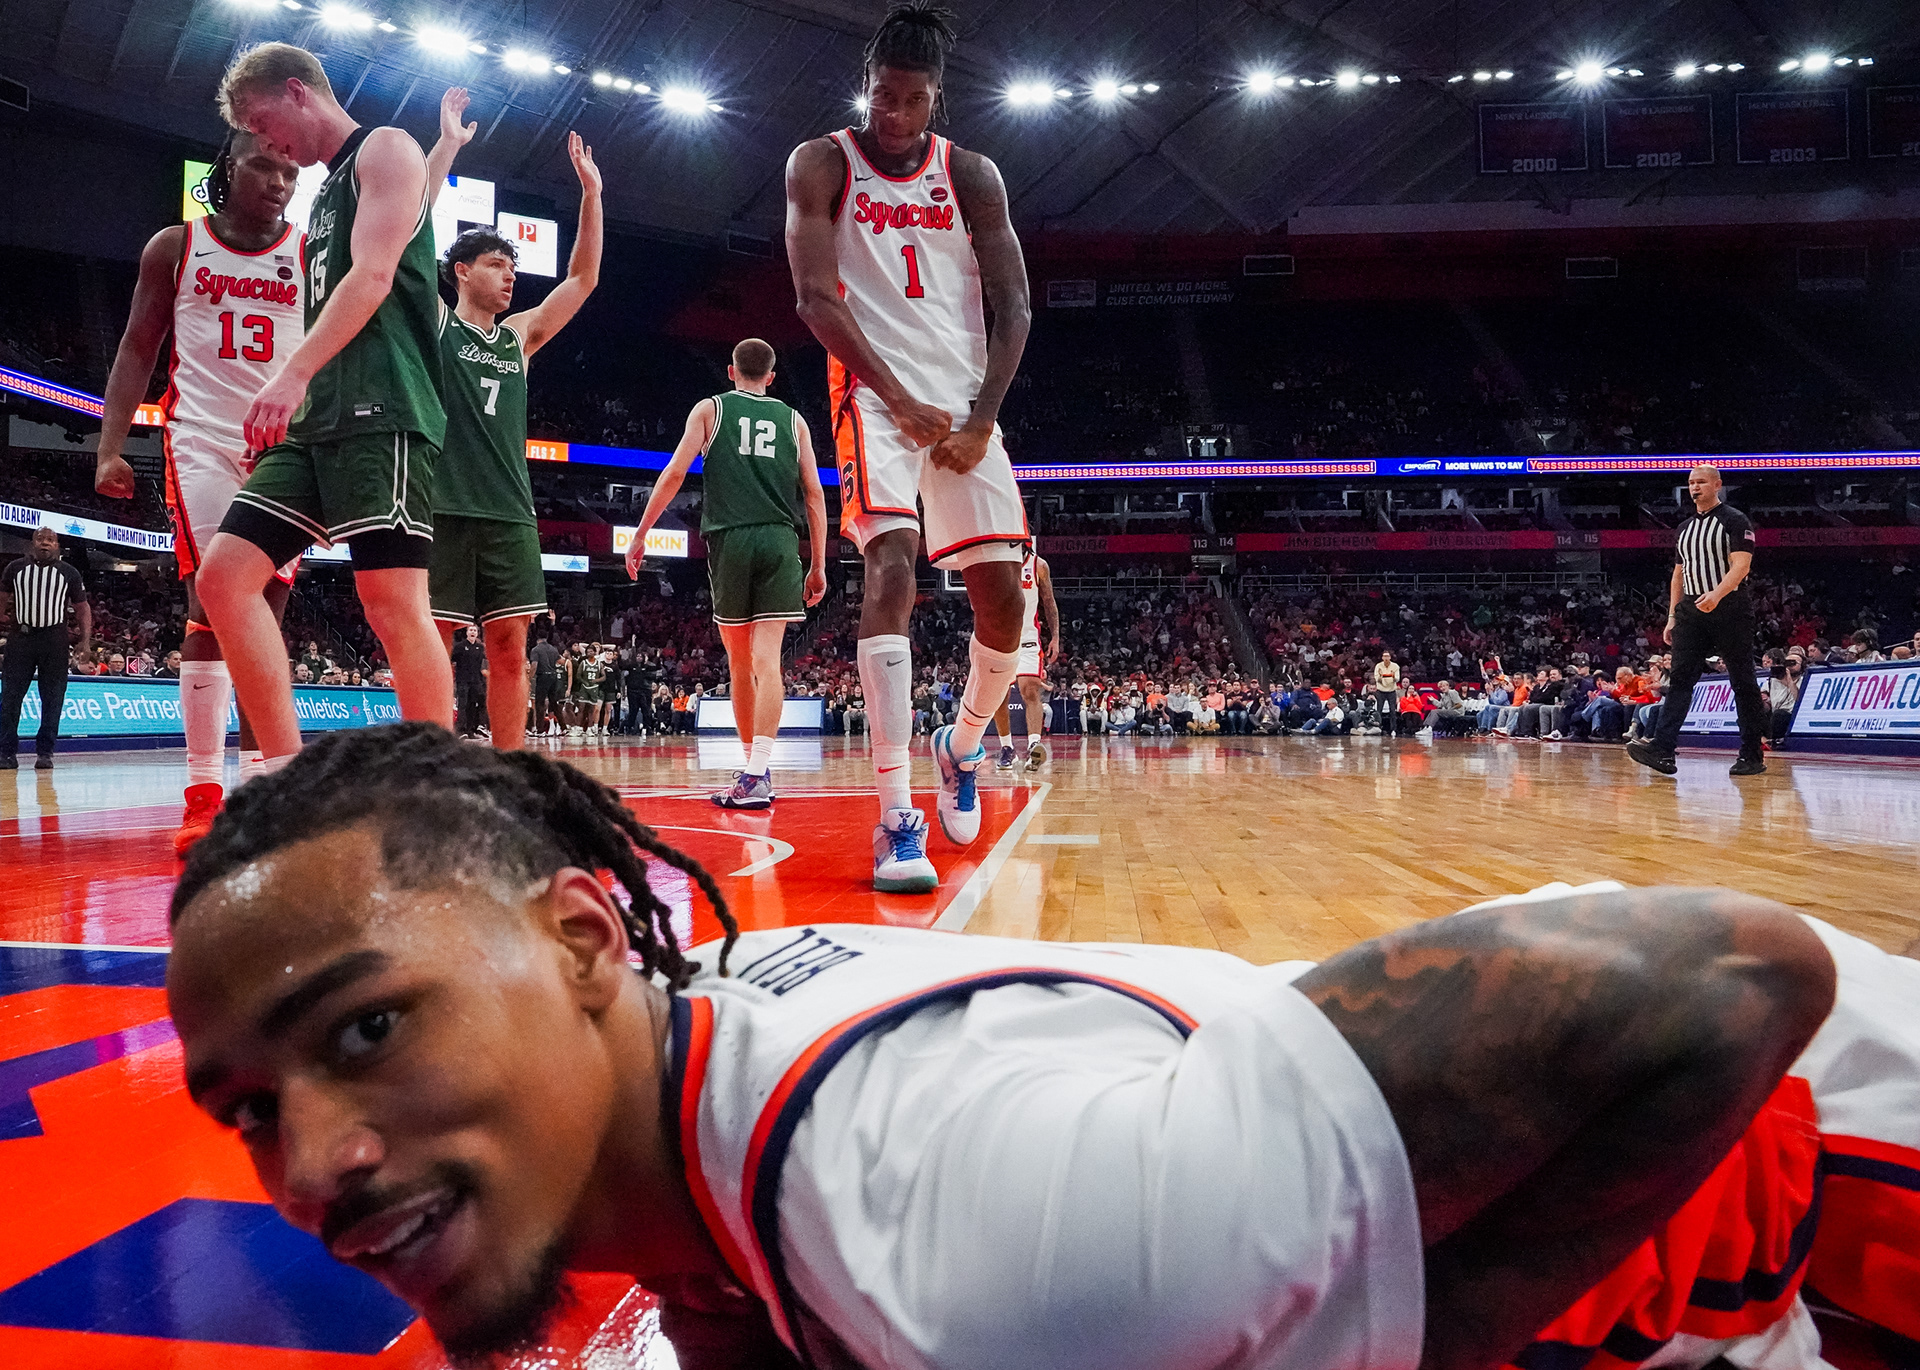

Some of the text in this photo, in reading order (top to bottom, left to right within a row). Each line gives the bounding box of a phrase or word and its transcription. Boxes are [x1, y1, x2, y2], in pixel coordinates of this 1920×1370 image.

[1636, 151, 1682, 168] 2002
[1769, 147, 1816, 163] 2003
[1512, 157, 1557, 173] 2000
[854, 192, 954, 235] Syracuse
[310, 246, 328, 309] 15
[900, 245, 925, 299] 1
[194, 267, 298, 307] Syracuse
[218, 311, 274, 363] 13
[480, 376, 502, 417] 7
[373, 405, 383, 413] XL
[135, 410, 160, 425] OL 3
[738, 416, 777, 460] 12
[531, 446, 556, 460] FLS 2
[1445, 461, 1524, 471] MORE WAYS TO SAY
[0, 505, 42, 527] TO ALBANY
[107, 525, 147, 547] BINGHAMTON
[147, 533, 157, 549] TO
[1193, 539, 1208, 549] 113
[1219, 537, 1234, 547] 114
[1557, 535, 1571, 545] 114
[1584, 533, 1599, 543] 115
[840, 546, 854, 554] 112
[587, 672, 596, 680] 22
[1843, 718, 1888, 731] TOM ANELLI
[737, 927, 864, 997] BELL
